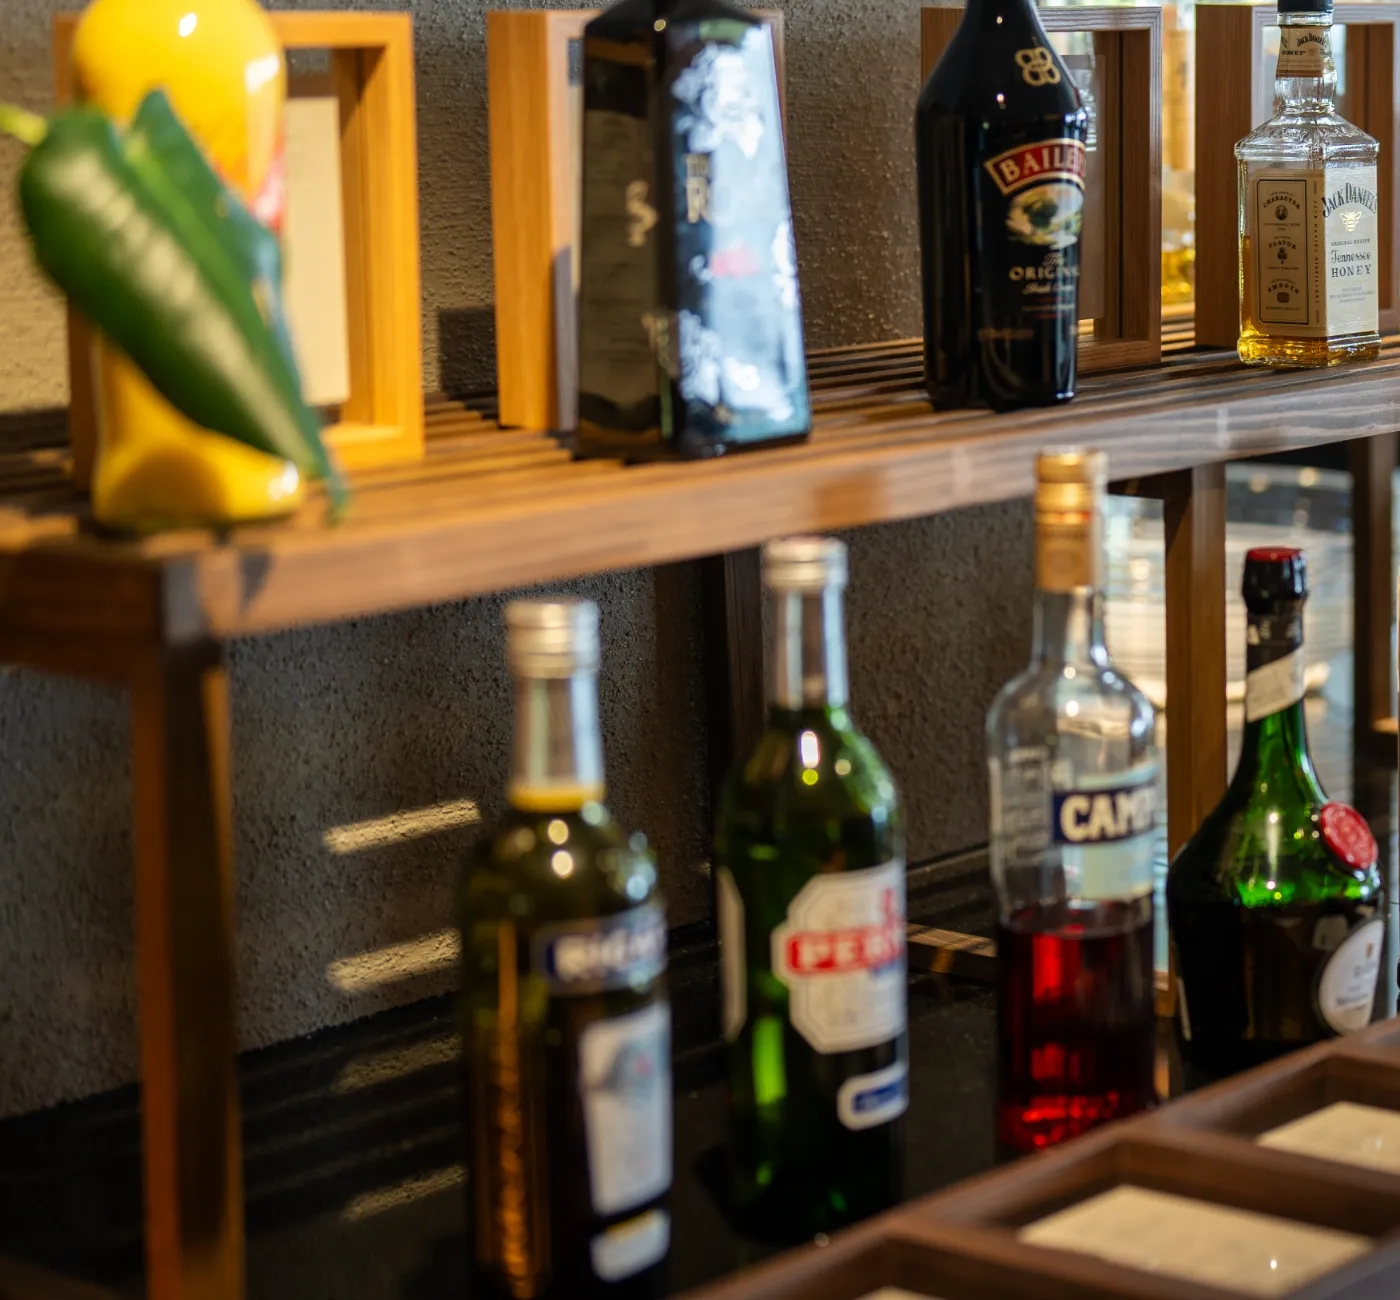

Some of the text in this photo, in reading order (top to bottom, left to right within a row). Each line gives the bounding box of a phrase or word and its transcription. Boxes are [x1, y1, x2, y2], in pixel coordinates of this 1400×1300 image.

[1320, 188, 1345, 218] JACK
[1330, 250, 1372, 264] Tennessee
[1331, 264, 1372, 278] HONEY
